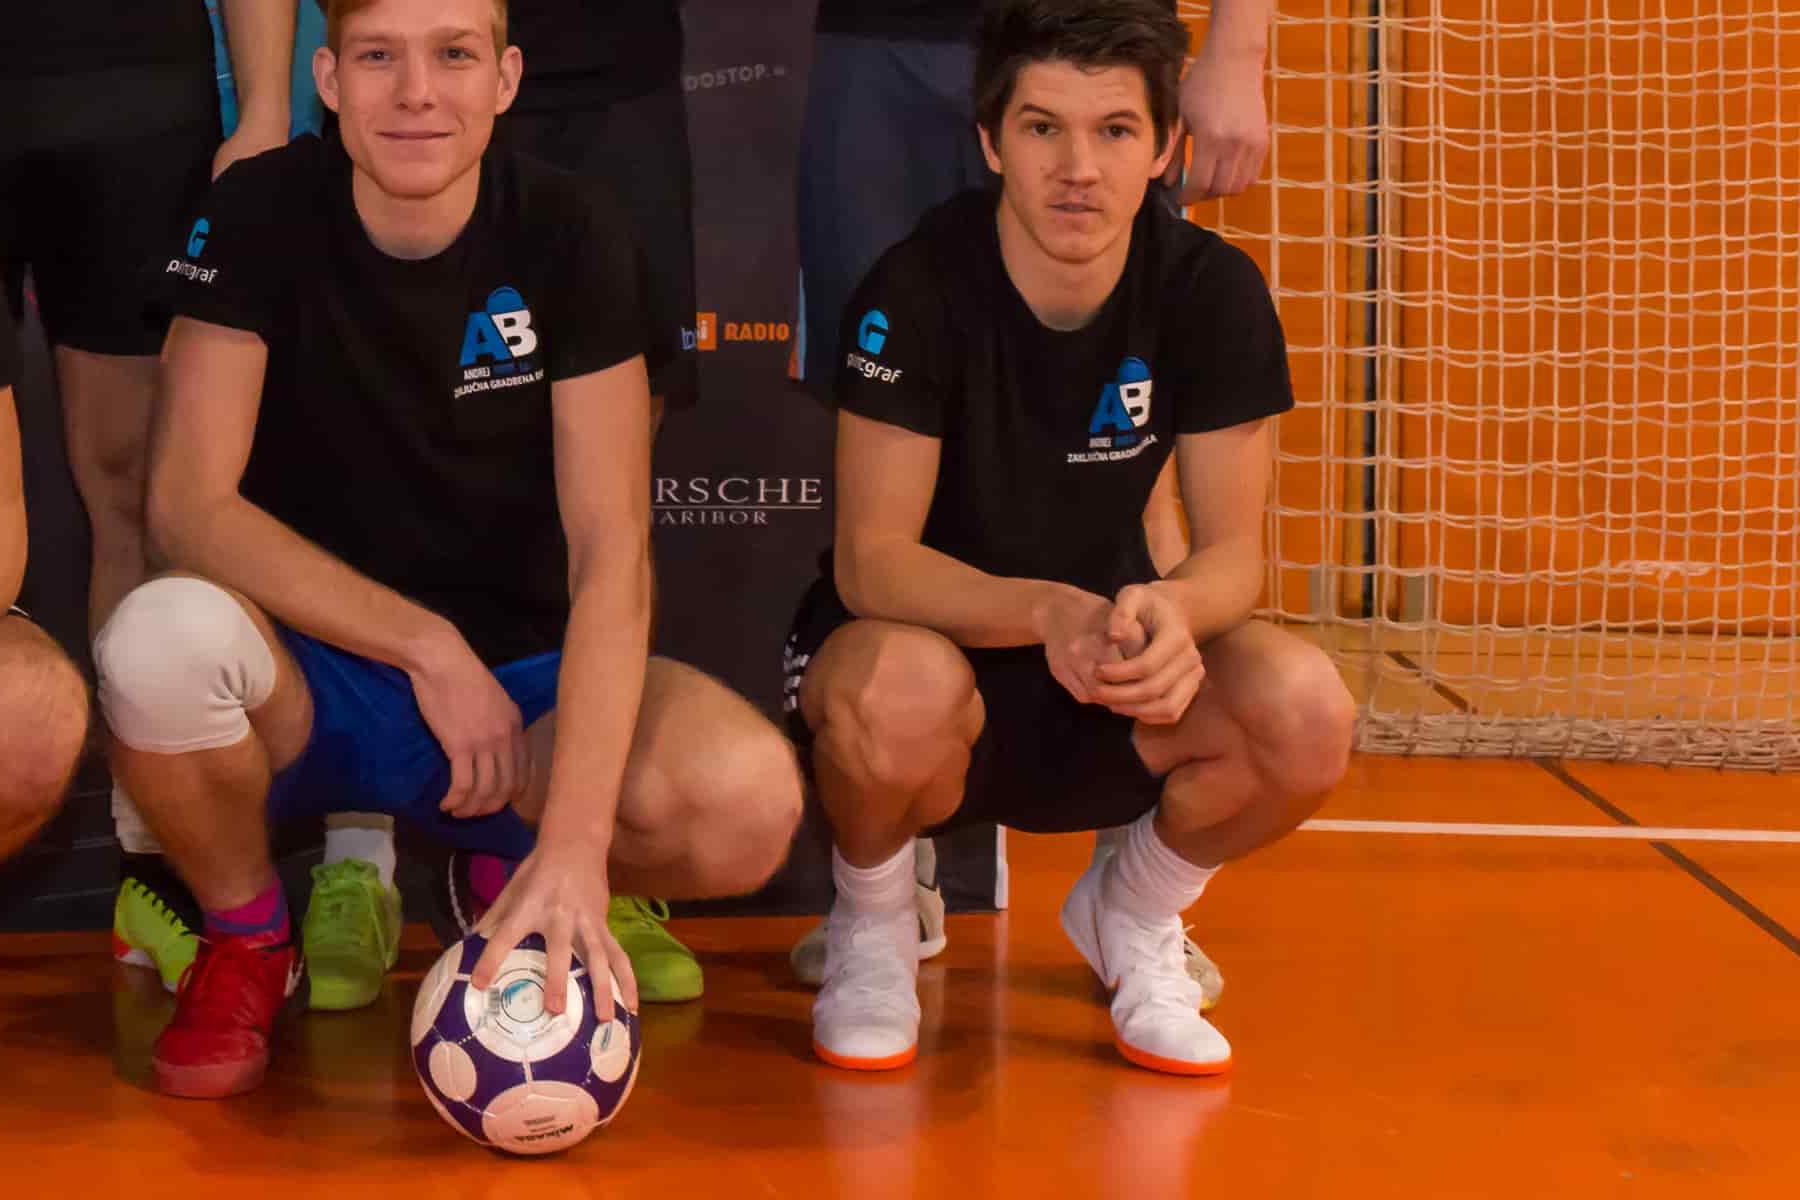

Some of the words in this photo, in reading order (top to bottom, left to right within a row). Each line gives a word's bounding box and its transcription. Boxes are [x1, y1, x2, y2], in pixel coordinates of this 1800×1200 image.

[459, 309, 538, 367] AB
[723, 321, 791, 342] RADIO
[1090, 380, 1153, 434] AB
[650, 510, 769, 526] ARIBOR
